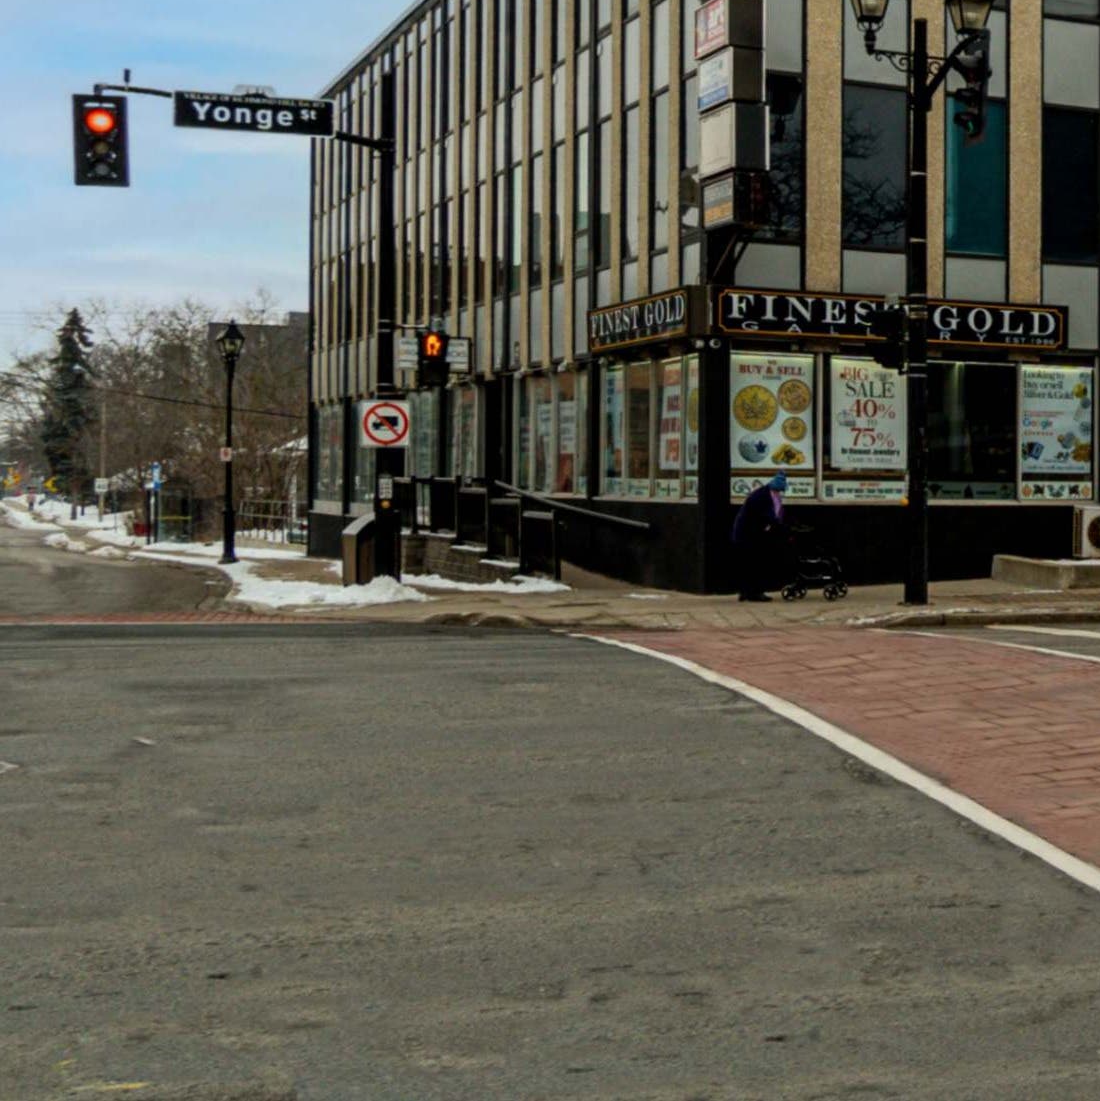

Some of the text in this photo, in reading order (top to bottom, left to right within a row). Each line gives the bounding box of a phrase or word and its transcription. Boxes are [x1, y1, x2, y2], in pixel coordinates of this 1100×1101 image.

[192, 101, 318, 130] Yonge St
[591, 304, 641, 338] FINEST
[643, 294, 685, 327] GOLD
[727, 292, 1057, 336] FINES GOLD
[738, 364, 805, 377] BUY & SELL
[843, 366, 869, 382] BIG
[845, 381, 895, 399] SALE
[851, 399, 896, 420] 40%
[850, 428, 895, 448] 75%
